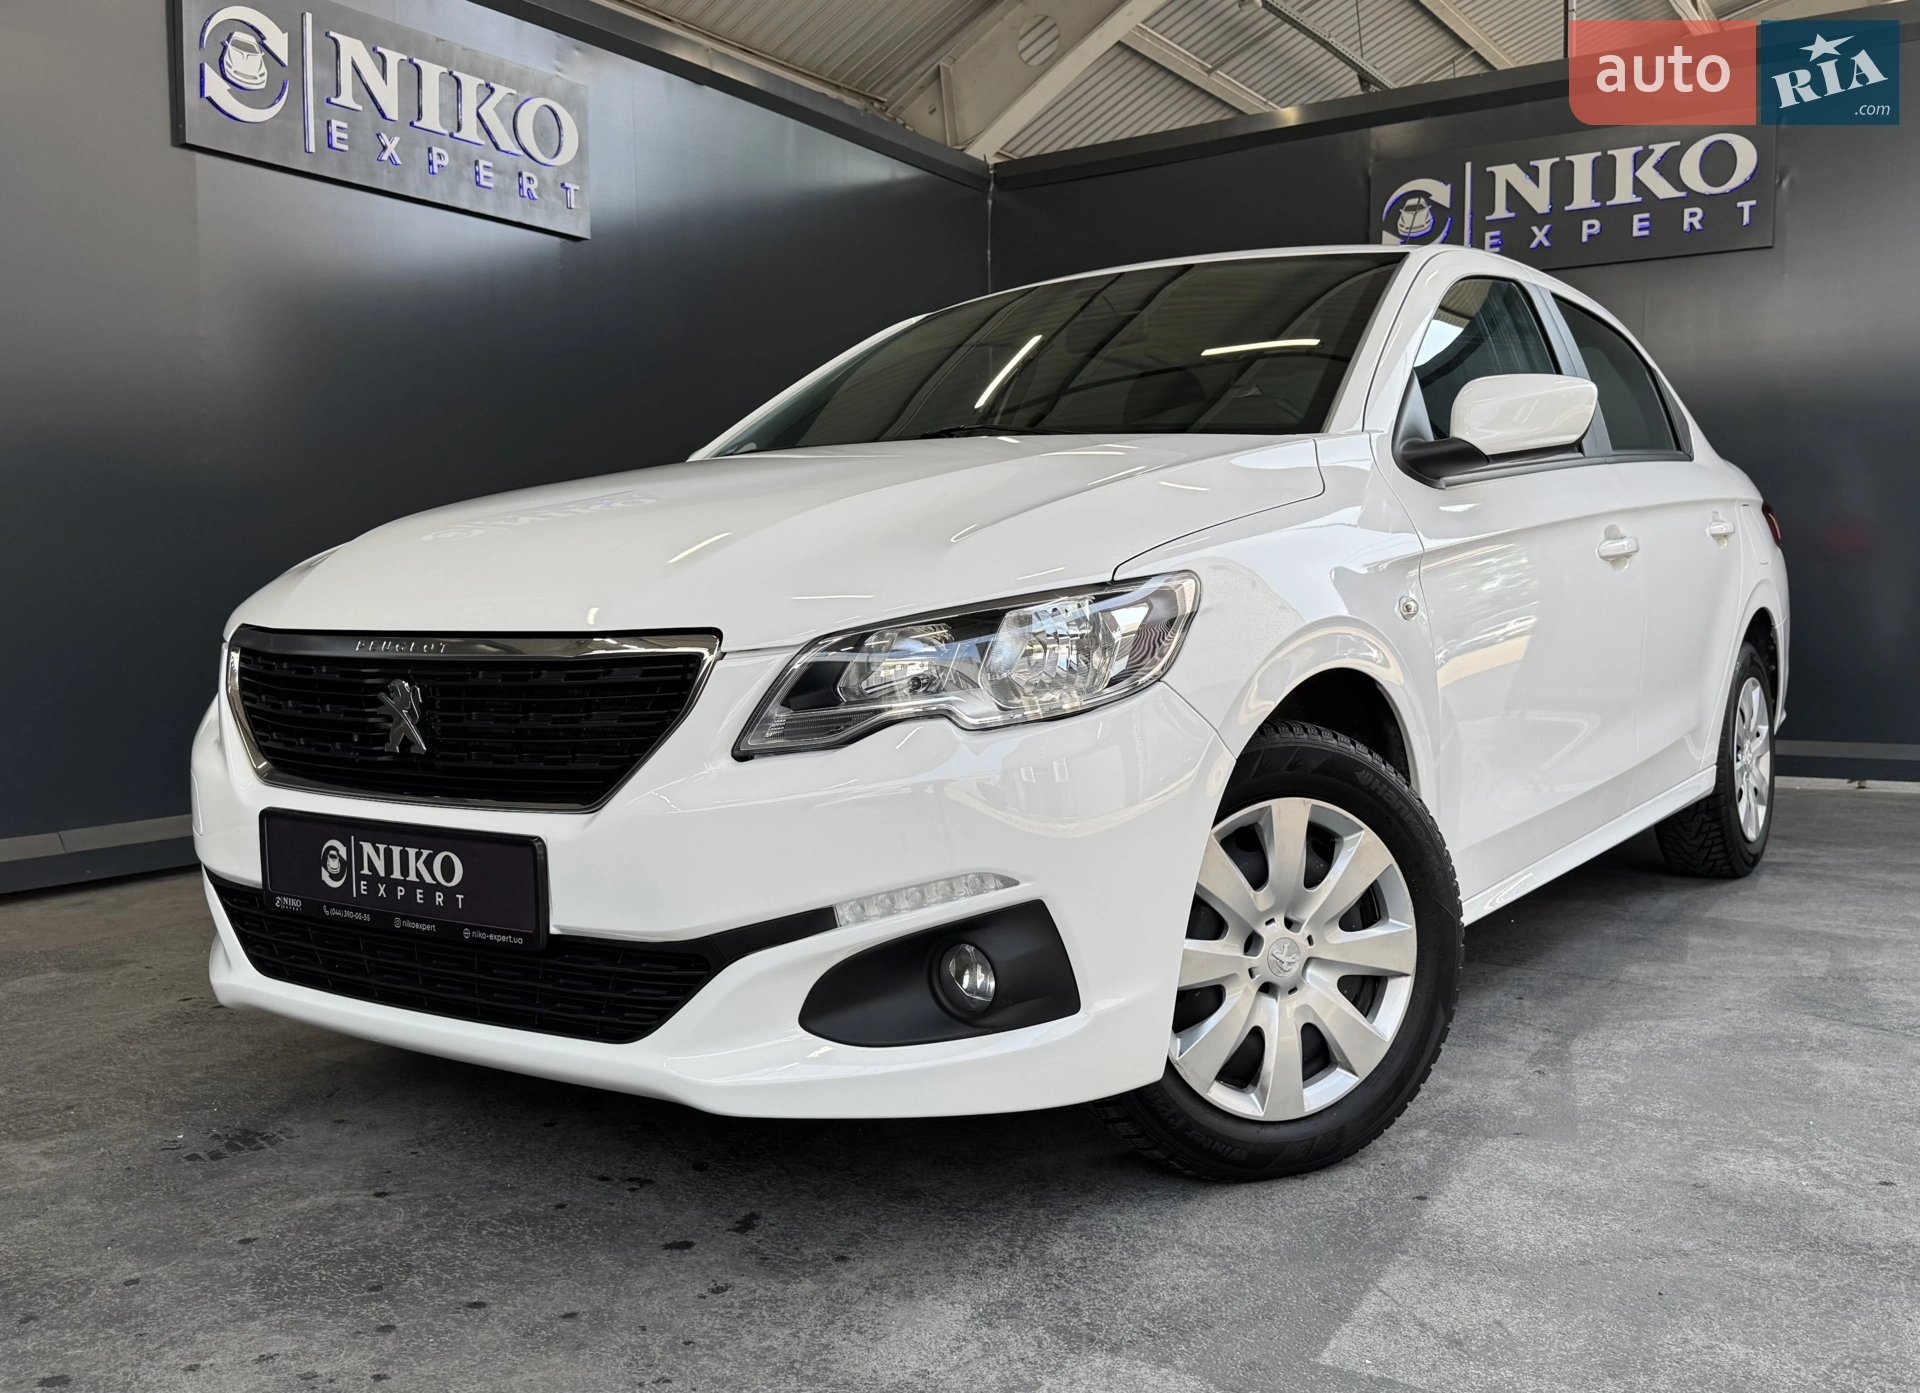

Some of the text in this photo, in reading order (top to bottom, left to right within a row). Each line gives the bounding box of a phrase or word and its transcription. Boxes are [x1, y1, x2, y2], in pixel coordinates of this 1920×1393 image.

[325, 30, 580, 167] NIKO
[327, 118, 581, 210] EXPERT
[1484, 132, 1759, 222] NIKO
[1484, 199, 1758, 253] EXPERT
[355, 640, 447, 654] PEUGEOT
[358, 841, 464, 887] NIKO
[283, 896, 302, 907] NIKO
[360, 880, 466, 909] EXPERT
[402, 919, 437, 932] nikoexpert
[471, 930, 523, 945] niko-expert.ua
